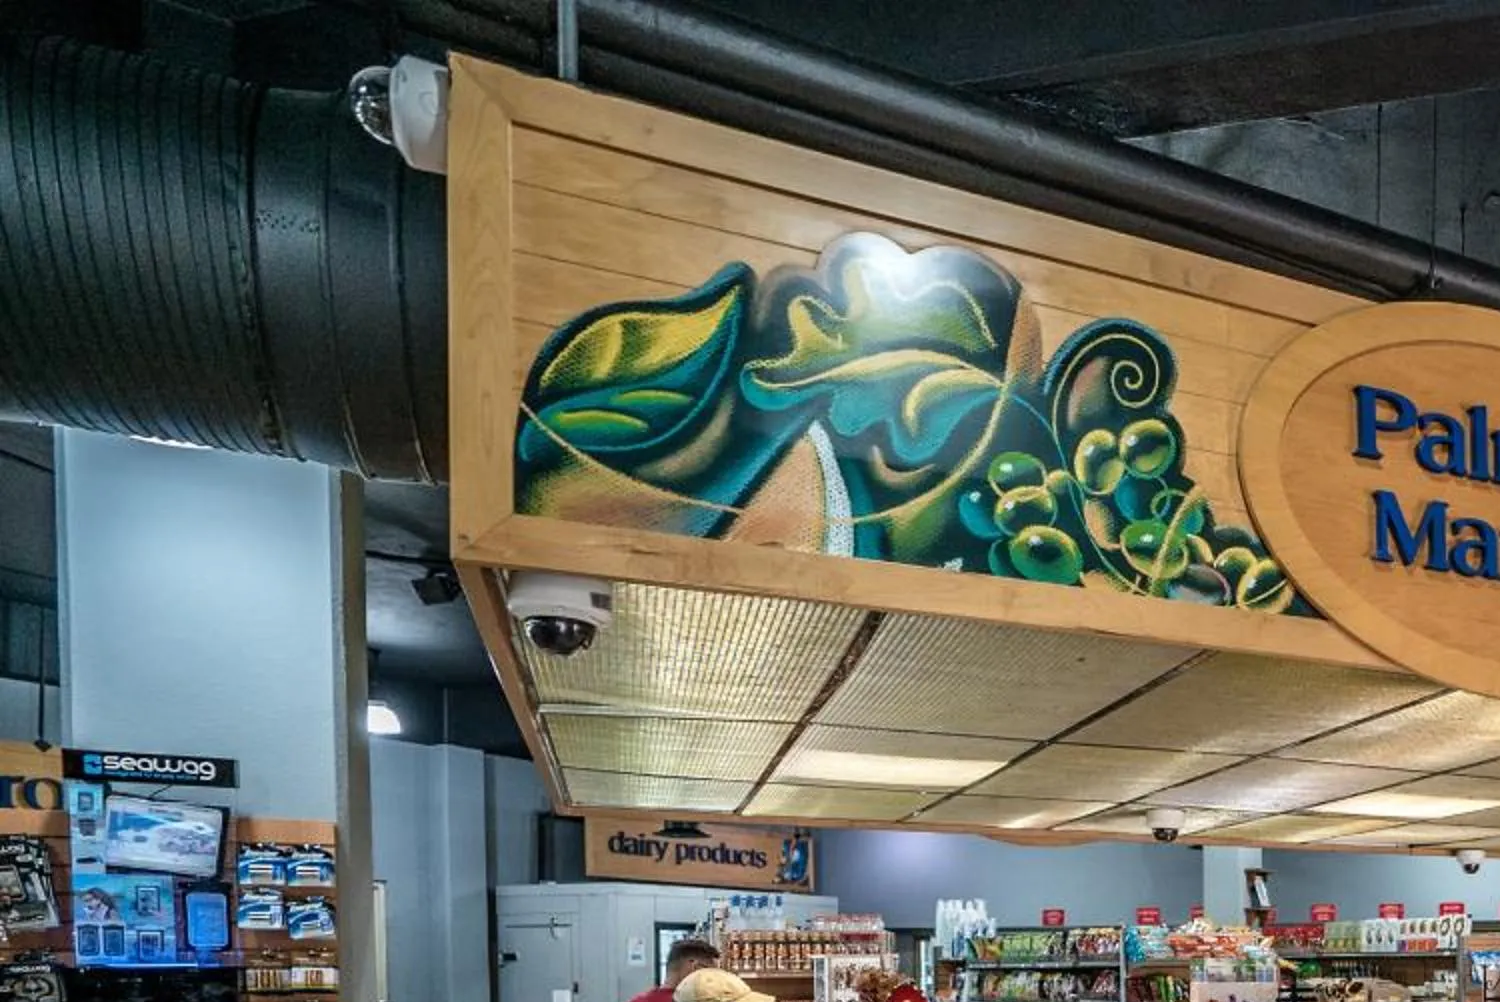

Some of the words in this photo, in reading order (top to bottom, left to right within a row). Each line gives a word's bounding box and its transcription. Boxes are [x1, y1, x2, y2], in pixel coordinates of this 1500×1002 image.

[103, 755, 217, 781] seawag
[608, 831, 669, 863] dairy
[675, 843, 768, 869] products
